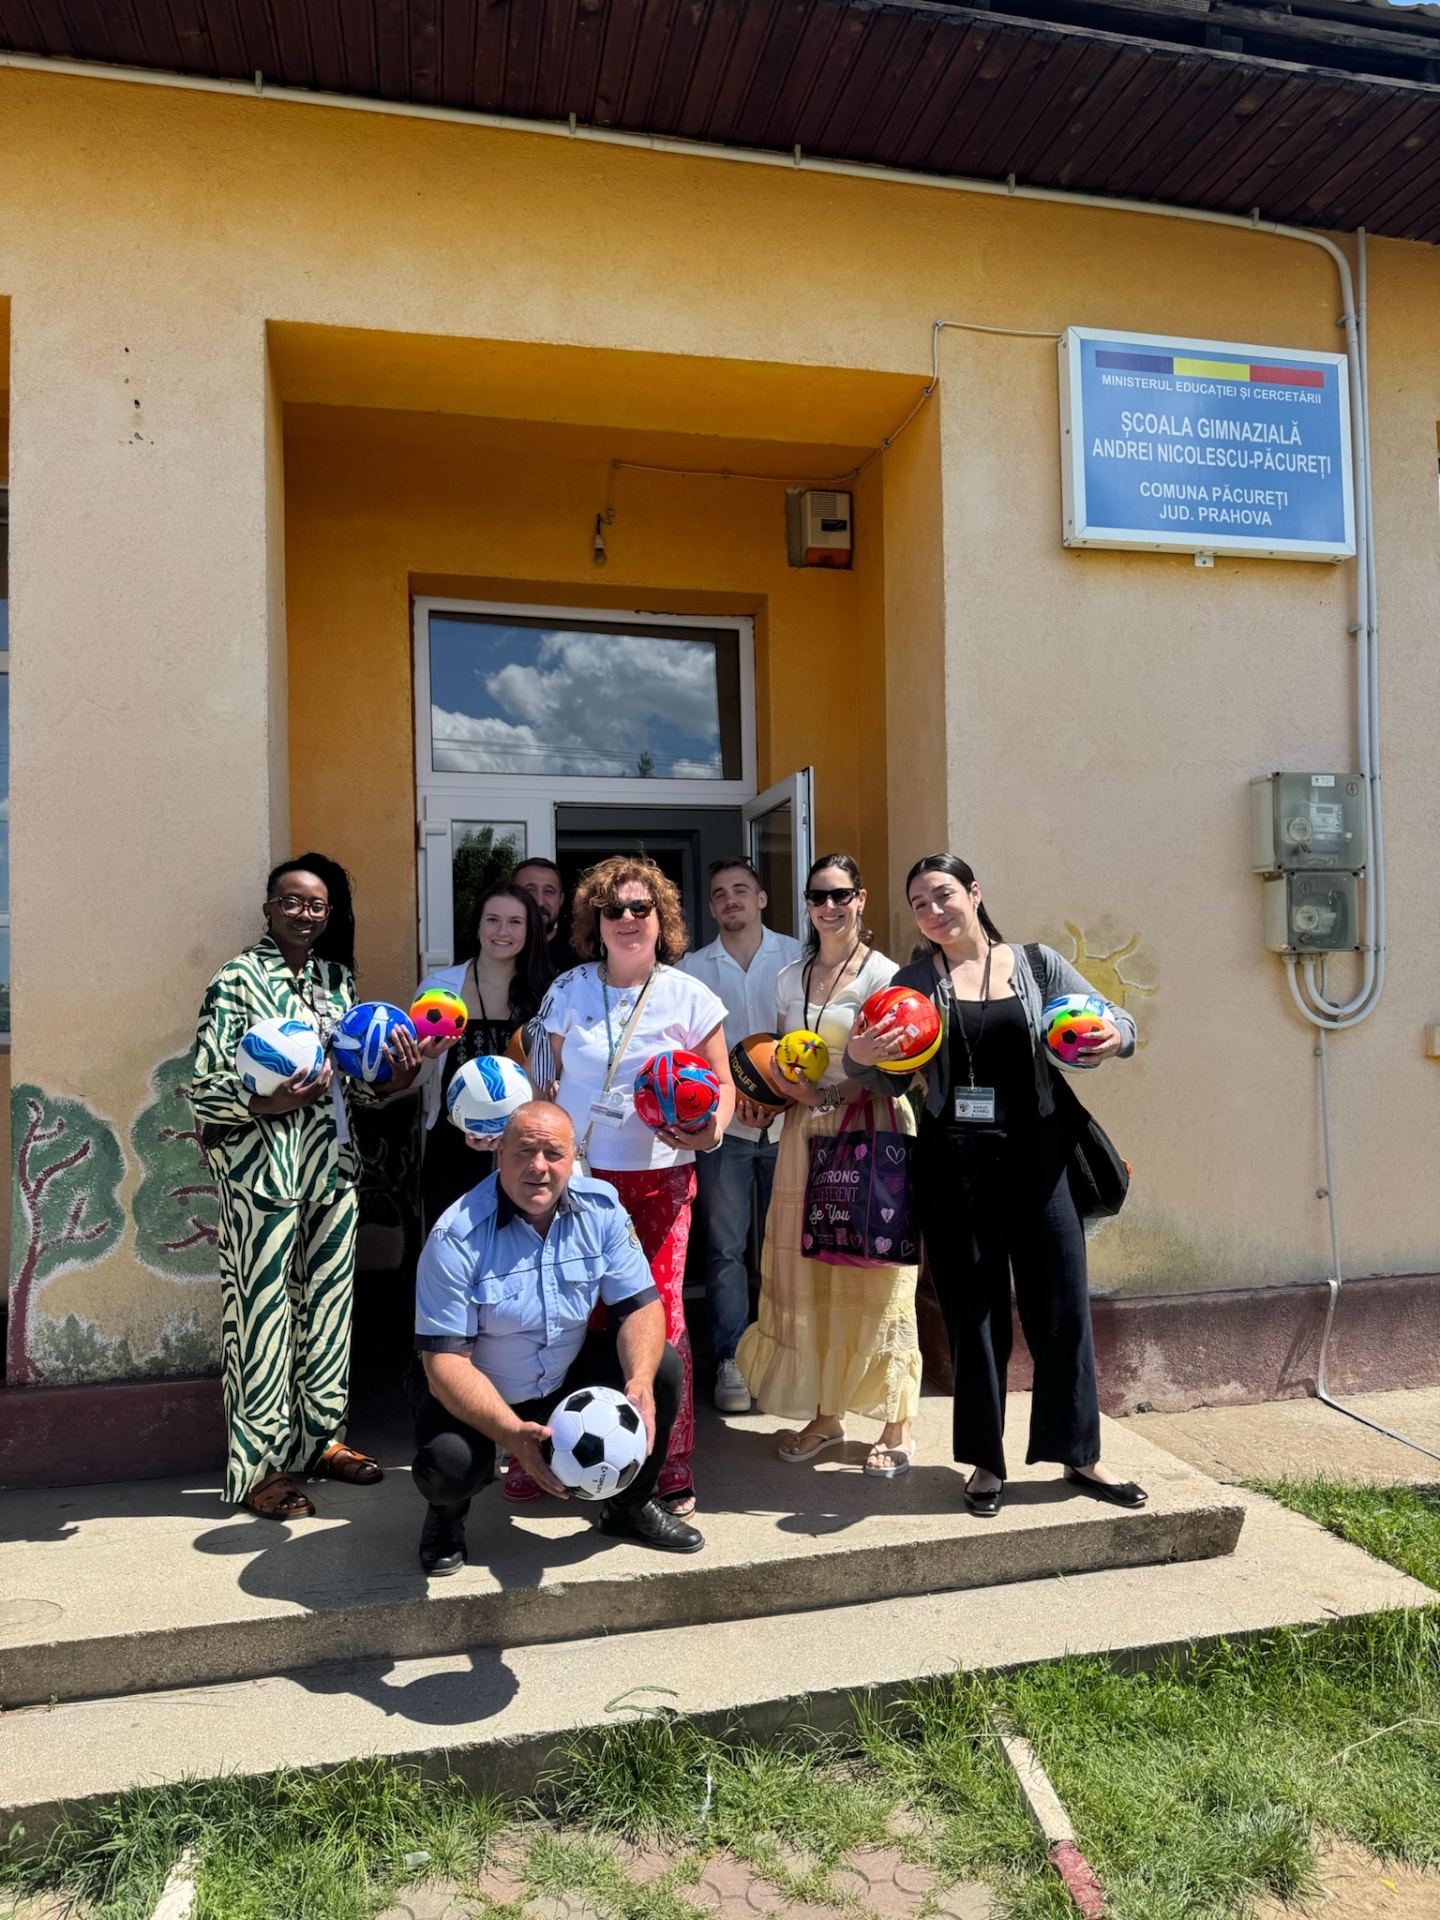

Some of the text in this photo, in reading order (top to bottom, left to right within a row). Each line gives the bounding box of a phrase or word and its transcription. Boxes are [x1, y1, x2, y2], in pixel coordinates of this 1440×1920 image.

[1102, 374, 1322, 404] MINISTERUL EDUCAȚIEI ȘI CERCETĂRII
[1121, 411, 1302, 445] ȘCOALA GIMNAZIALĂ
[1092, 438, 1153, 461] ANDREI
[1140, 481, 1289, 510] COMUNA PĂCUREȚI
[1159, 504, 1273, 526] JUD. PRAHOVA
[730, 1055, 758, 1092] TOPLIFE
[825, 1203, 851, 1225] You
